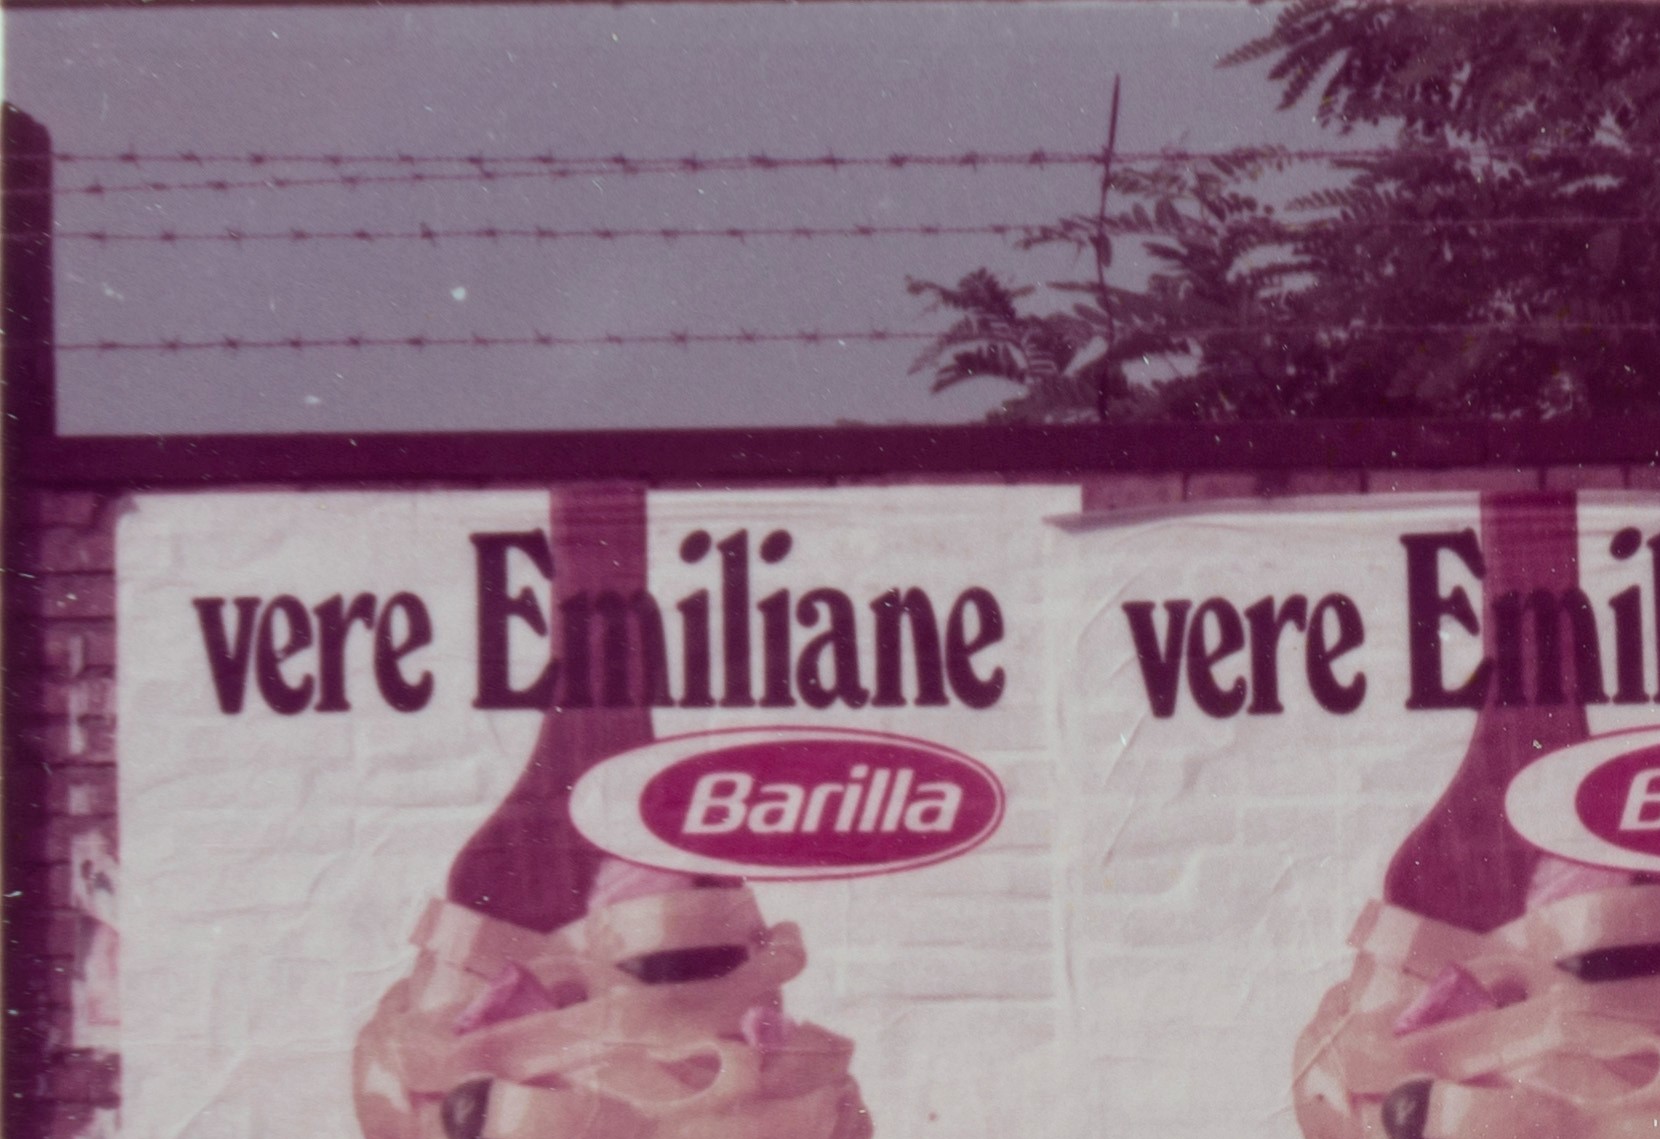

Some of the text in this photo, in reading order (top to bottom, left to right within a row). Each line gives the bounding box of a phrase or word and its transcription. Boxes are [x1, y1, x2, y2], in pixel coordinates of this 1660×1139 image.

[193, 528, 1006, 714] vere Emiliane
[1122, 592, 1367, 718] vere
[681, 764, 963, 834] Barilla
